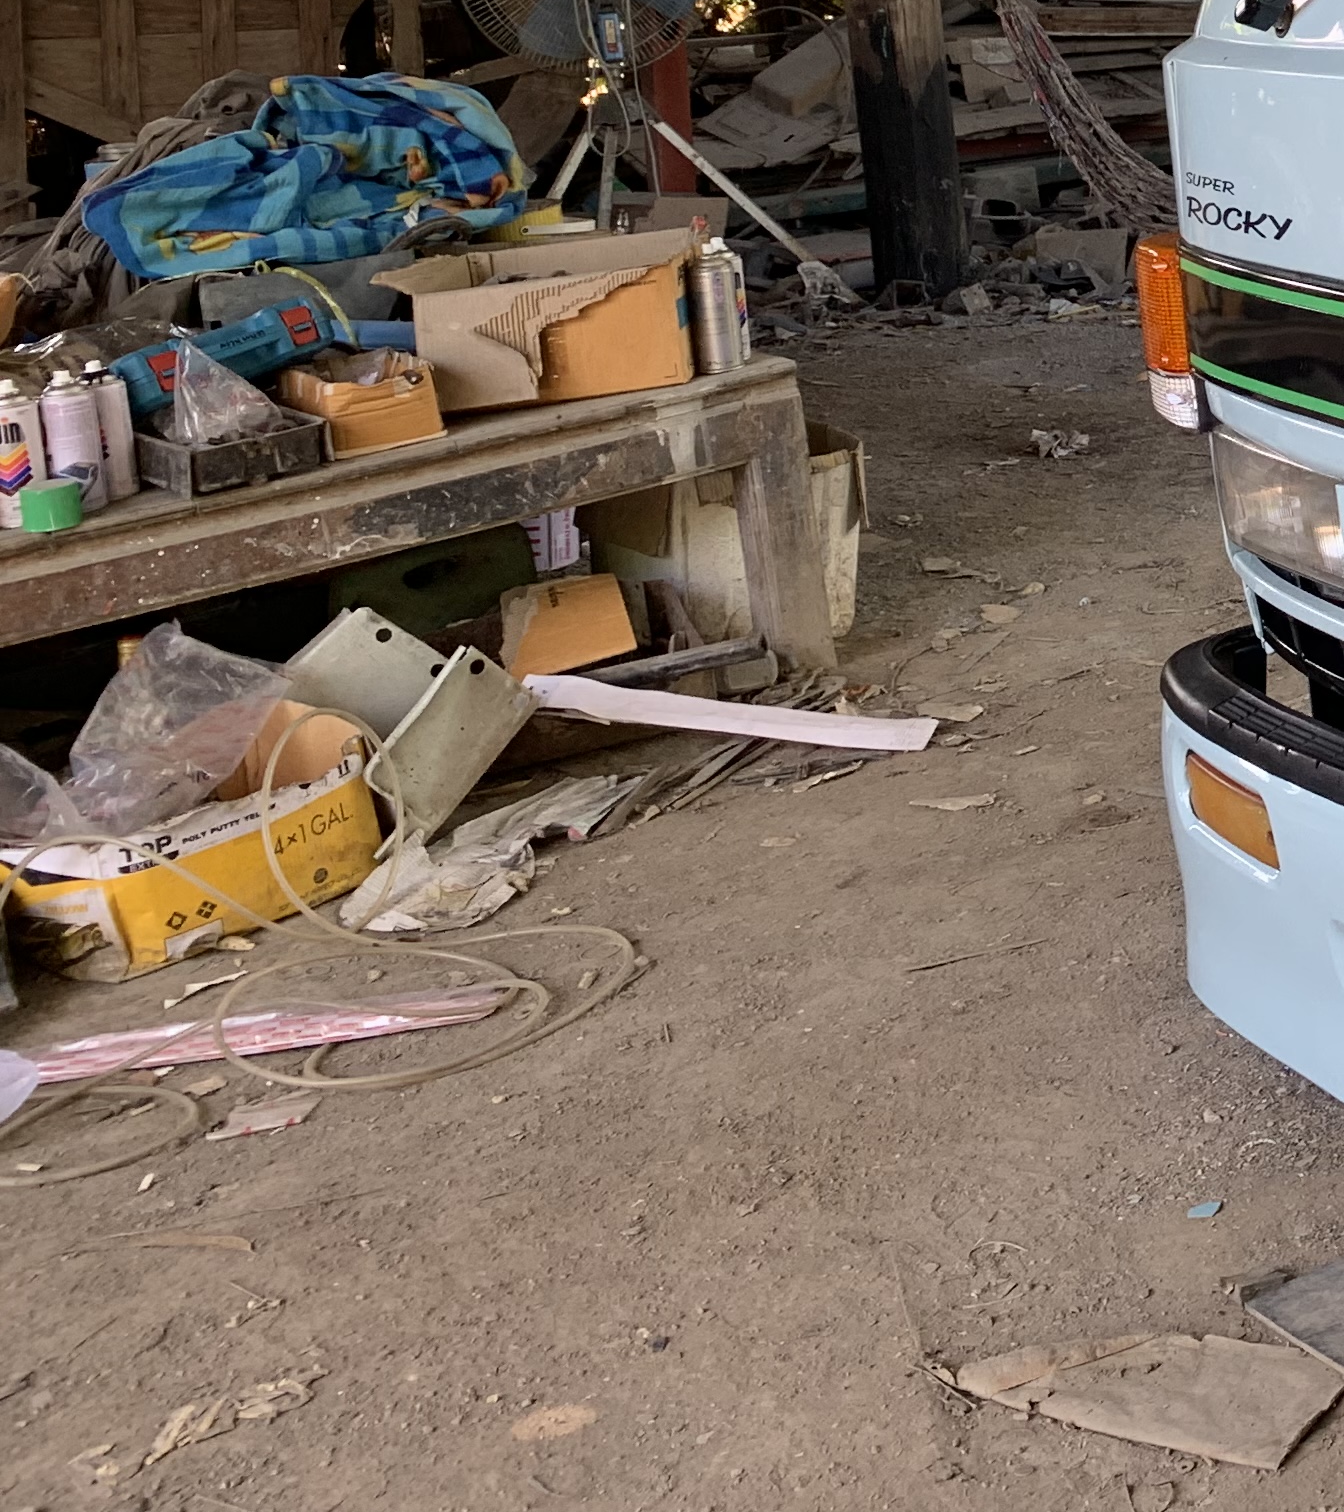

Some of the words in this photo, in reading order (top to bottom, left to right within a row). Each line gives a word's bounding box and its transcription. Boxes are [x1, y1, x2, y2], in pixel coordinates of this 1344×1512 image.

[1185, 171, 1235, 196] SUPER
[1186, 195, 1293, 241] ROCKY
[310, 802, 354, 837] GAL.
